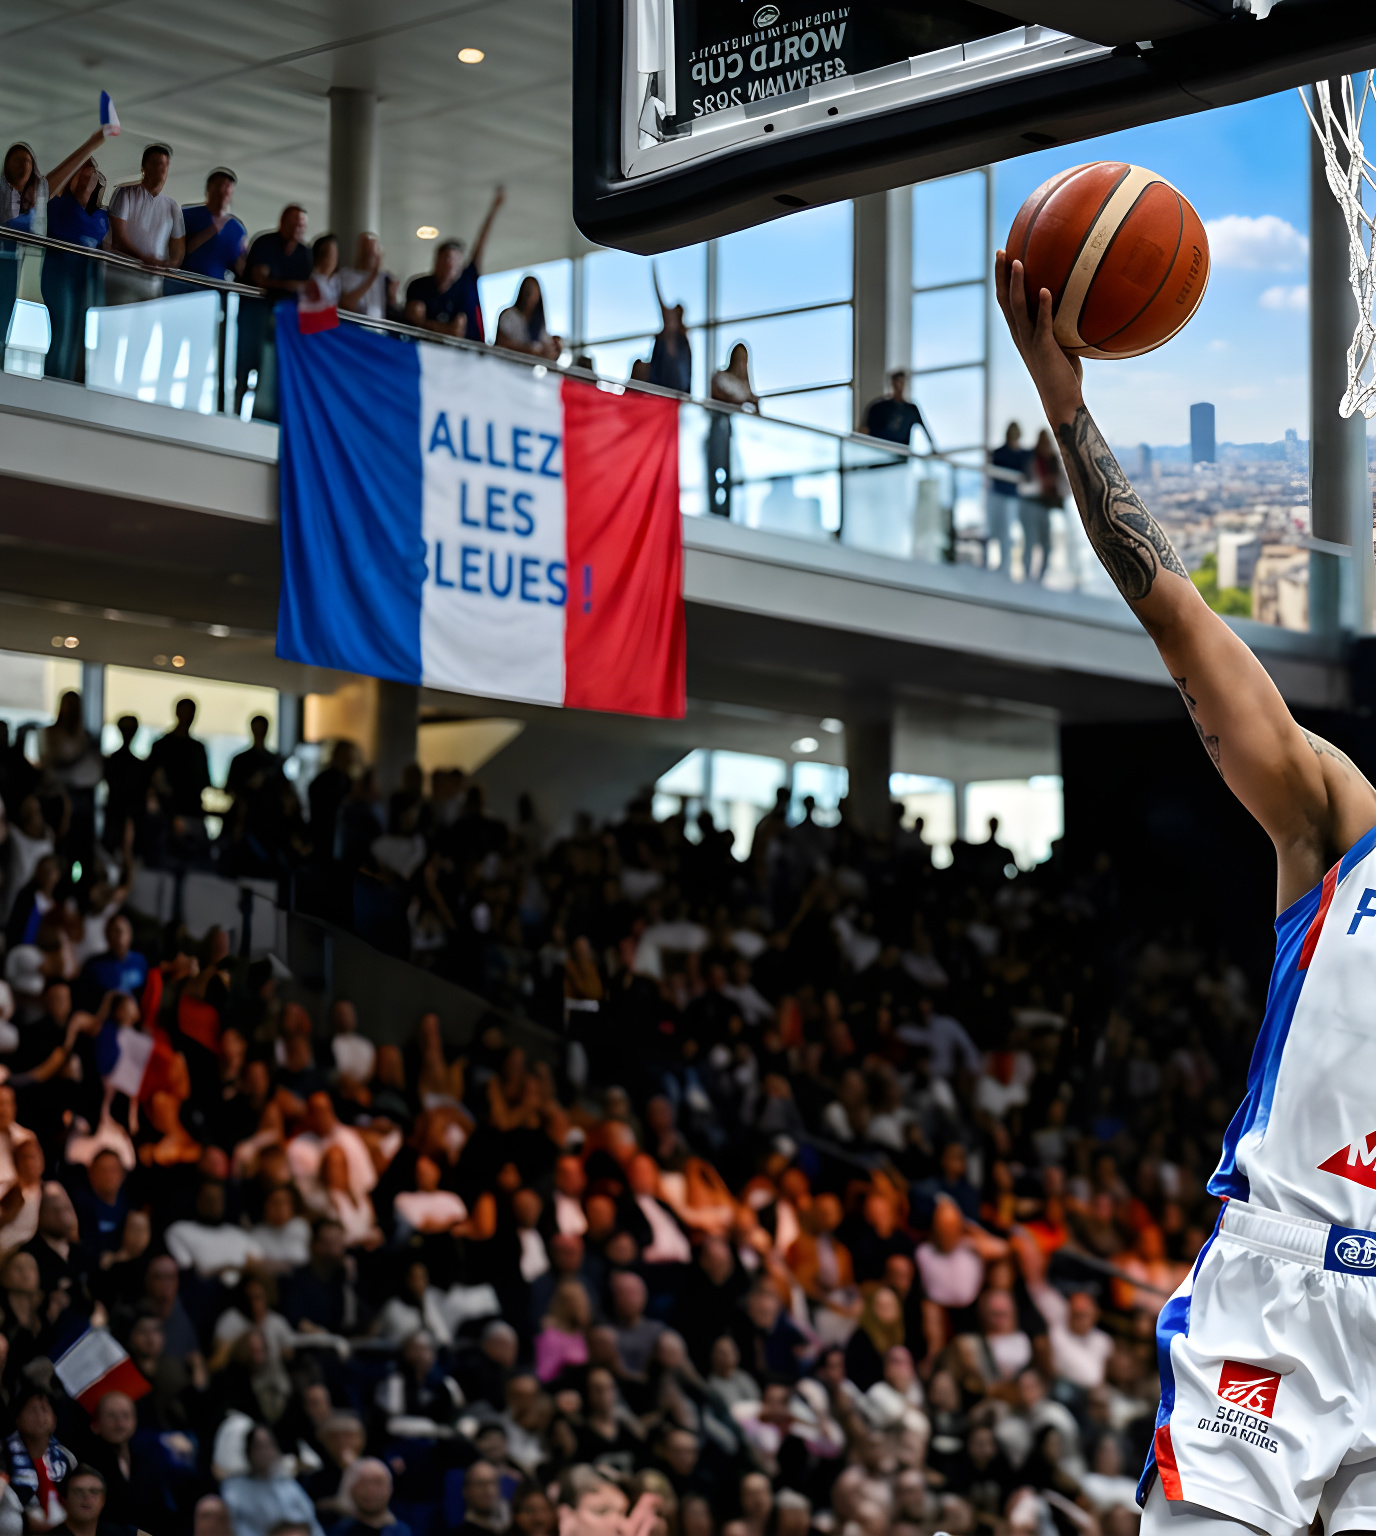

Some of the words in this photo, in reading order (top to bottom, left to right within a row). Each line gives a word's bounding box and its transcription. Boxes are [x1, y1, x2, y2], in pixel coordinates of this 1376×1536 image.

[429, 411, 561, 478] ALLEZ
[461, 481, 535, 537] LES
[423, 541, 568, 607] LEUES
